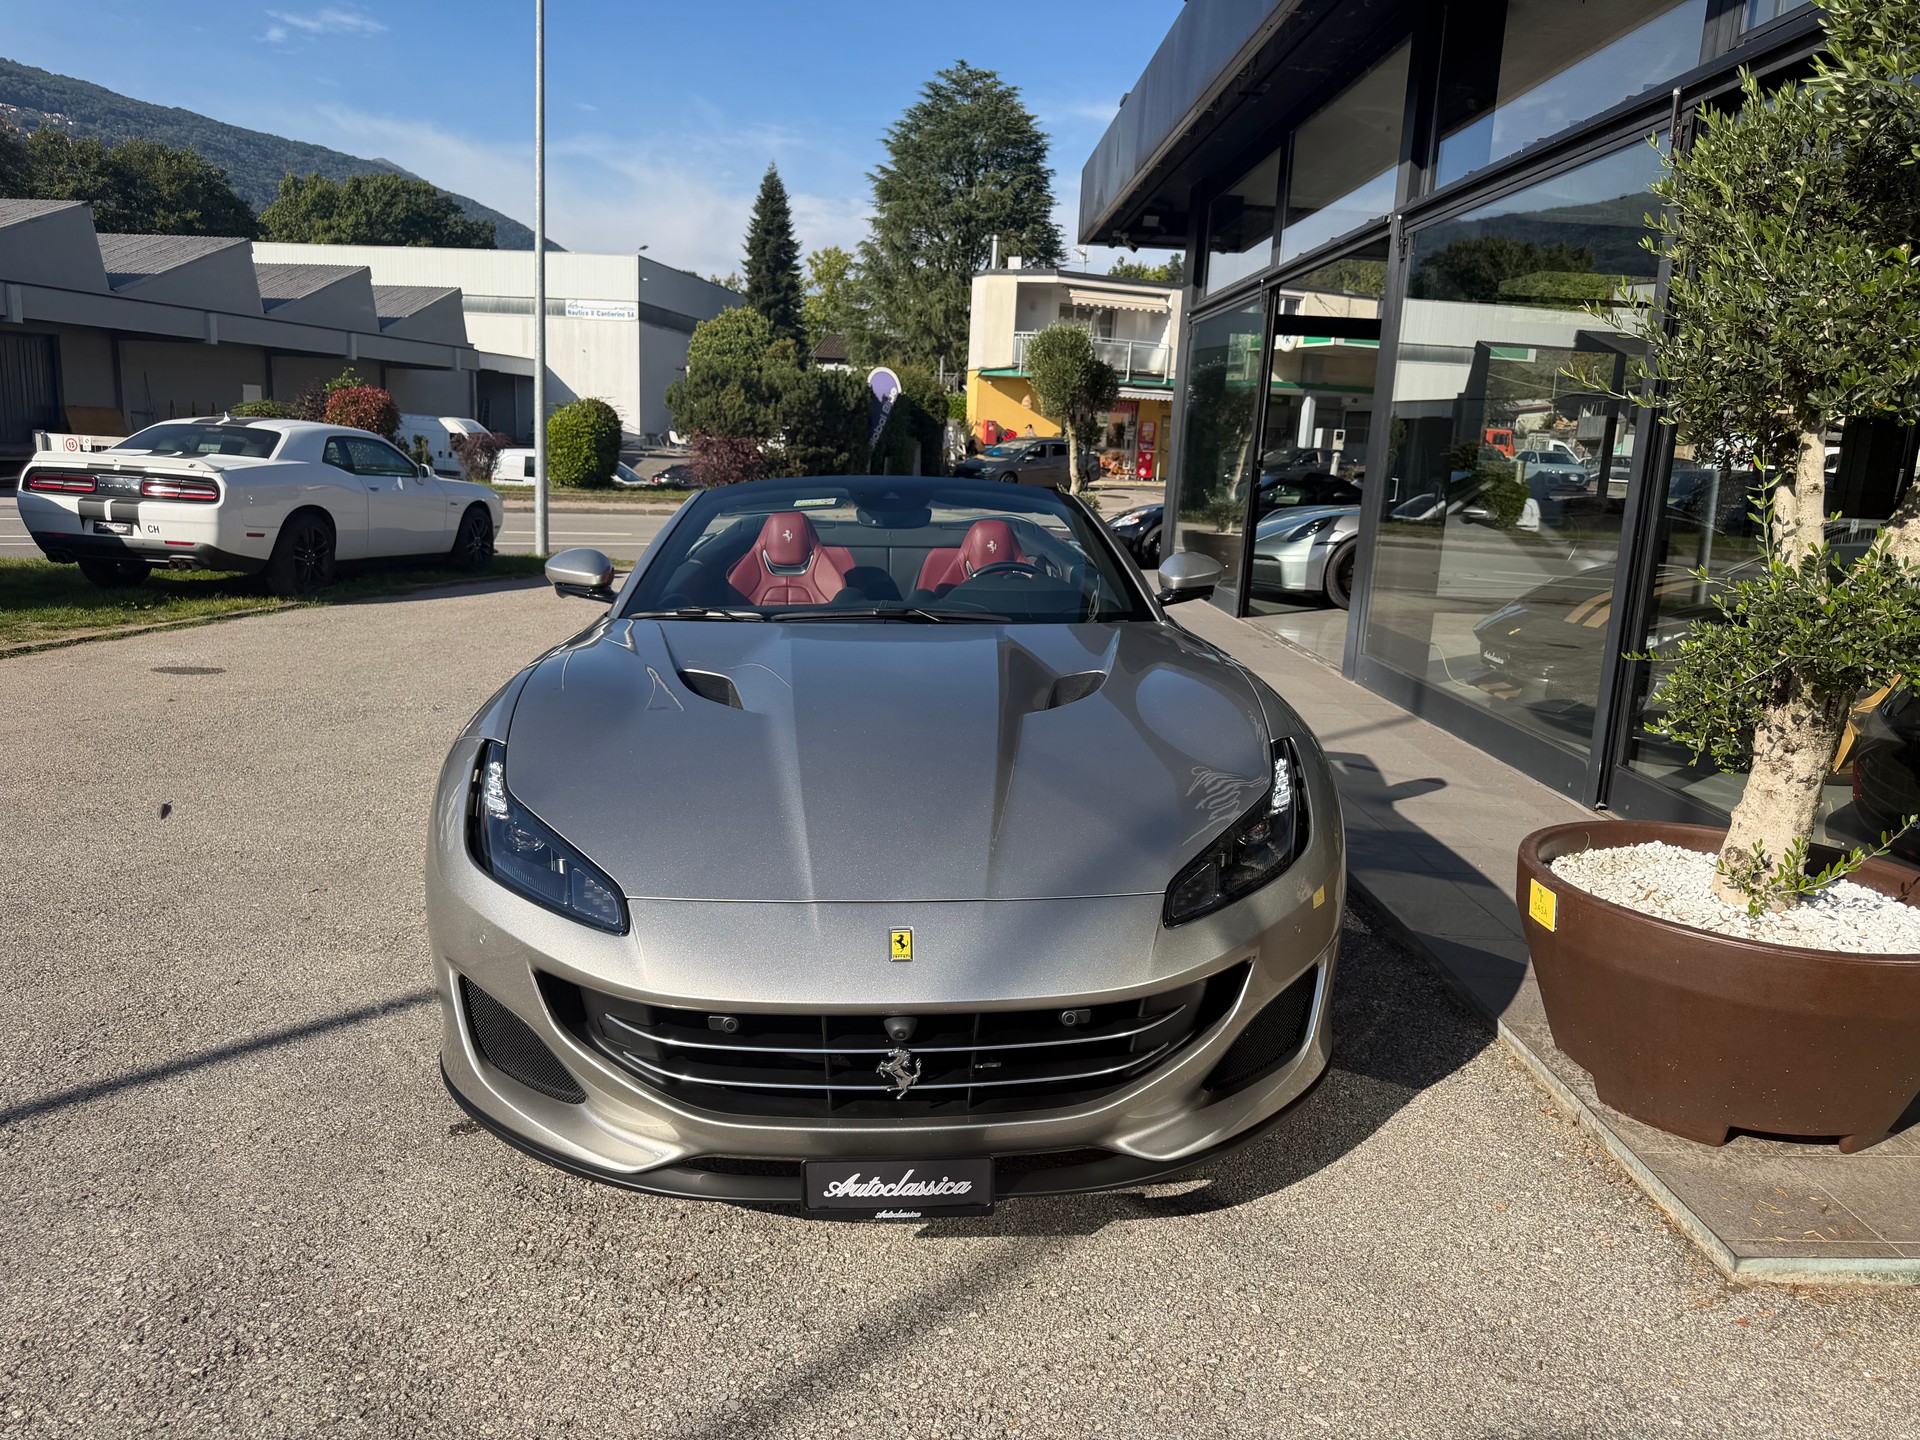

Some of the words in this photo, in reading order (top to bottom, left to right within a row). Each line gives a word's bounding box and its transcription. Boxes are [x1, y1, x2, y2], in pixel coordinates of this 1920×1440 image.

[882, 387, 898, 414] Blue
[147, 524, 160, 534] CH
[823, 1169, 973, 1198] Autoclassica
